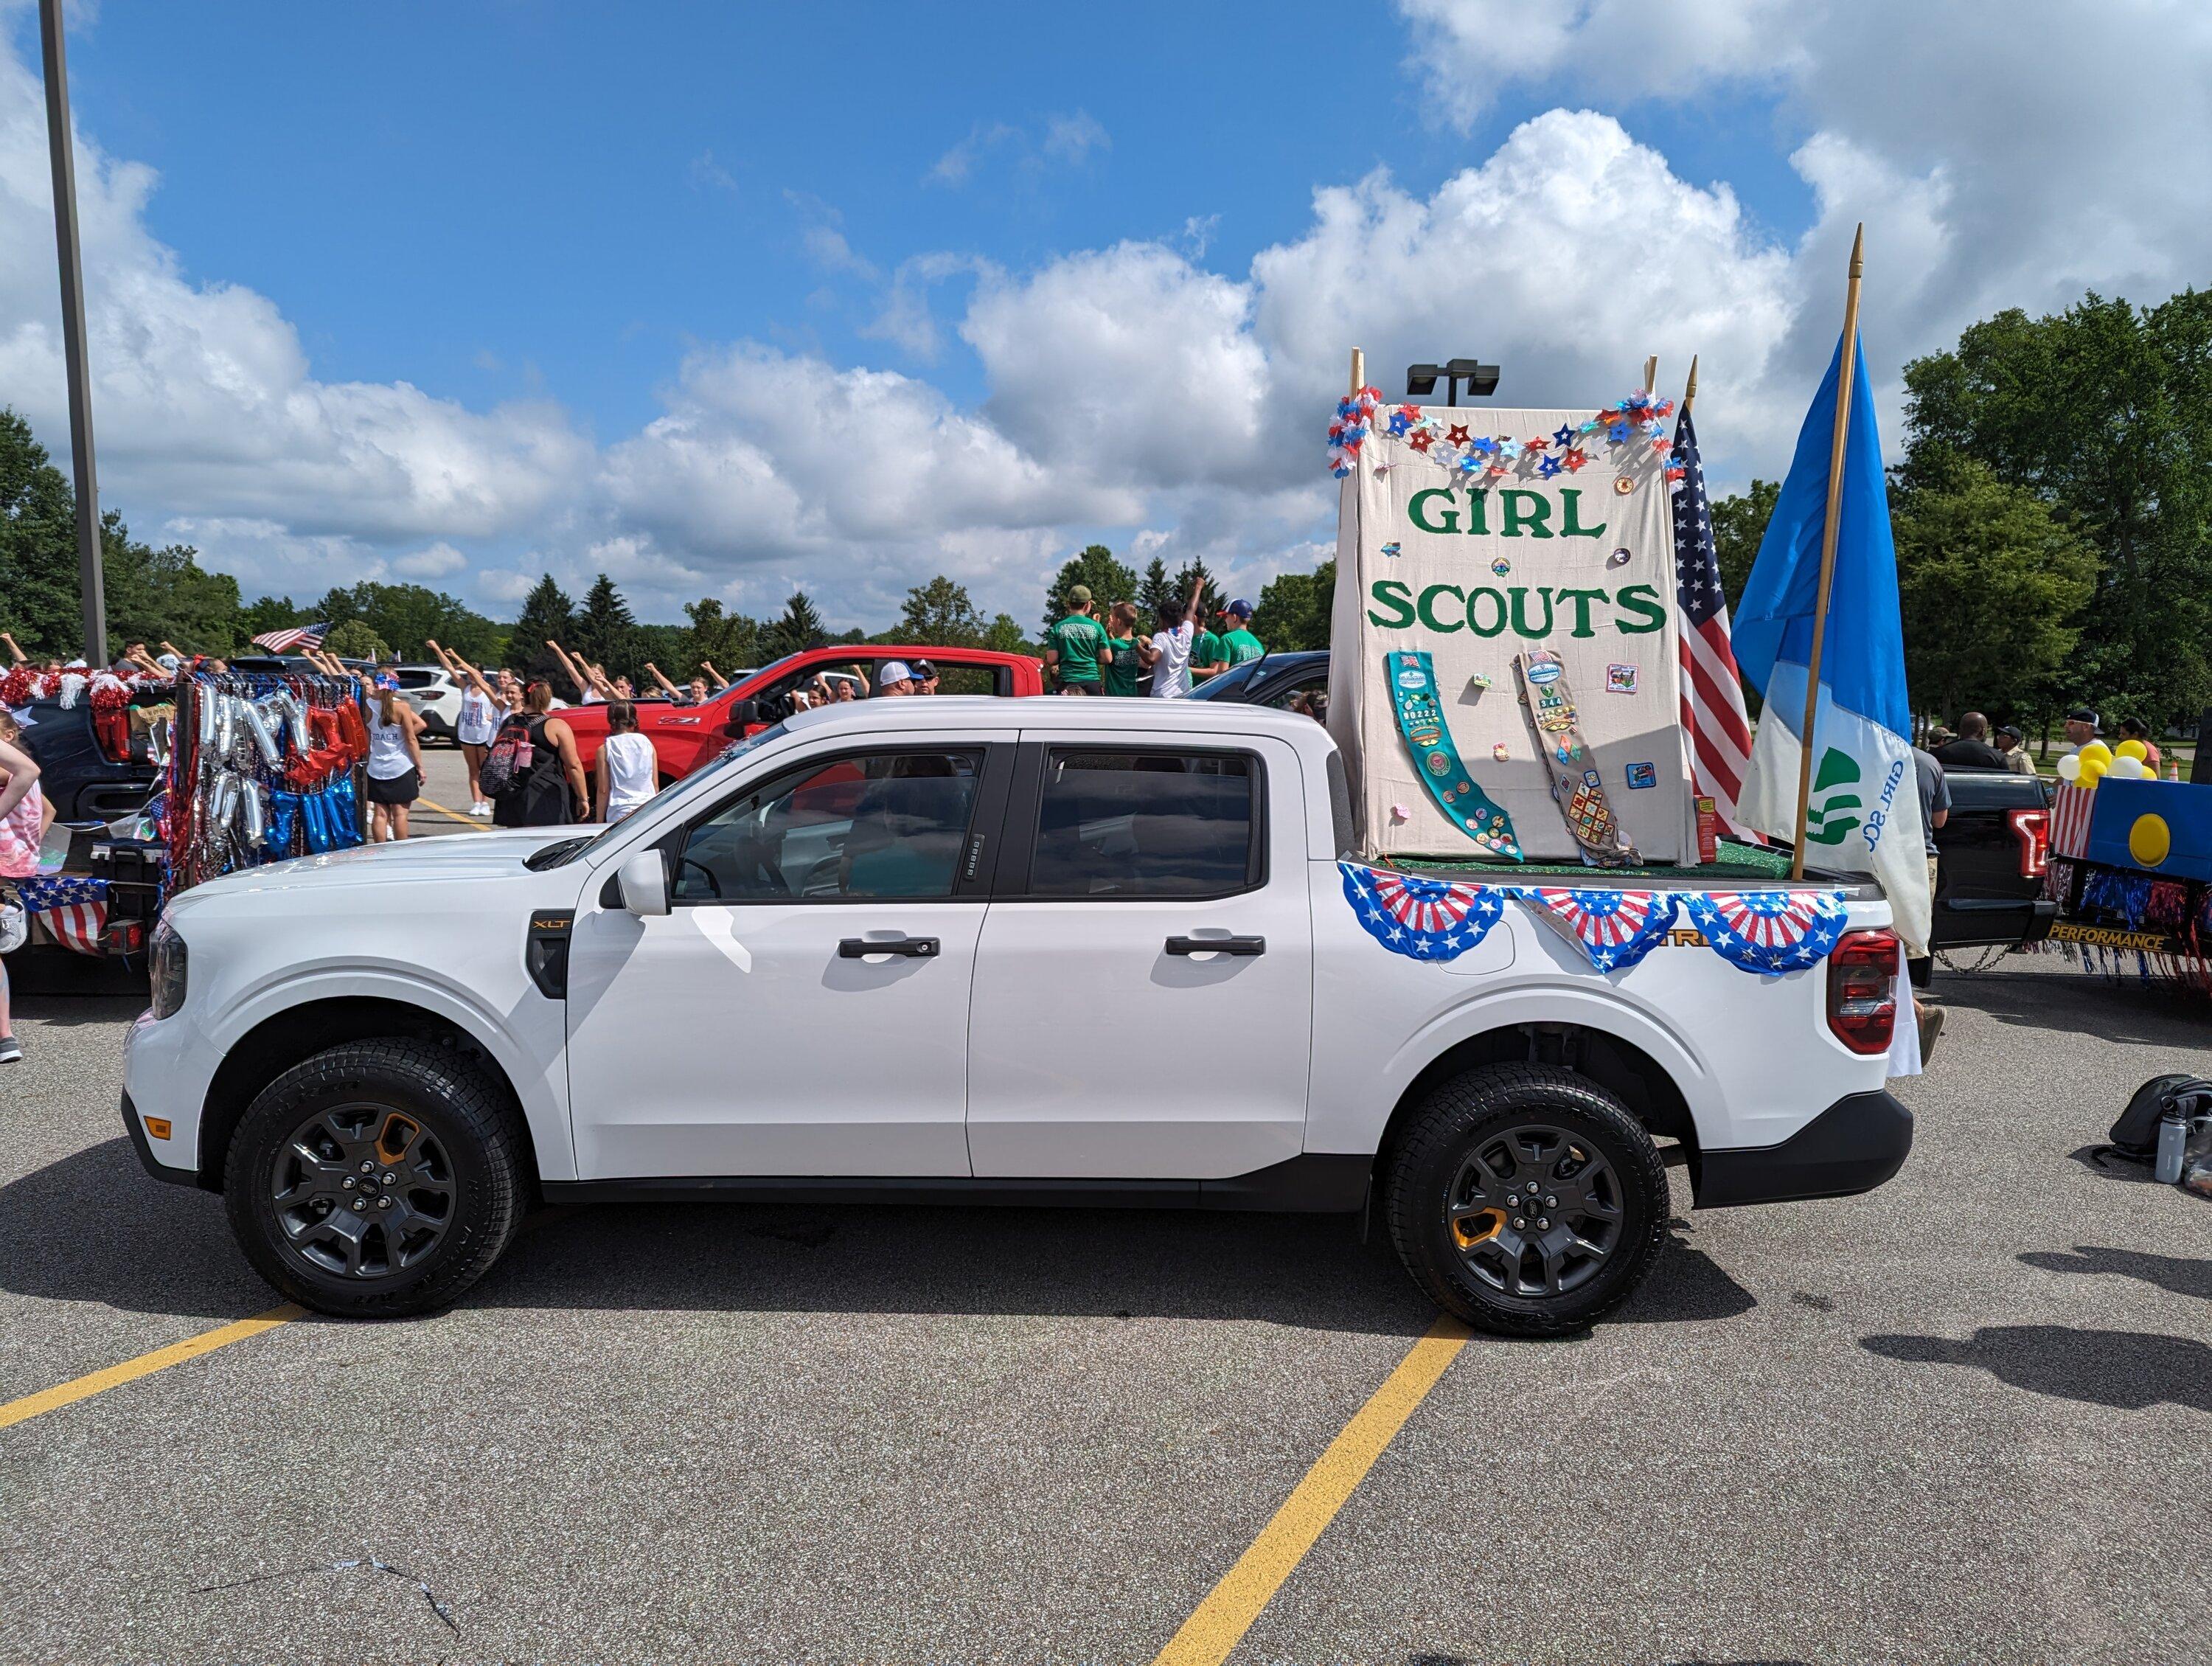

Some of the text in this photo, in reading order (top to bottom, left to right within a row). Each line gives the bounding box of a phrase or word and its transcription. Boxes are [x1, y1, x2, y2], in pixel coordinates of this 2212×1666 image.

[1408, 488, 1607, 539] GIRL
[1368, 580, 1667, 639] SCOUTS
[1541, 698, 1562, 707] 344
[1403, 709, 1437, 721] 90222
[533, 920, 571, 929] XLT
[2048, 925, 2166, 950] PERFORMANCE
